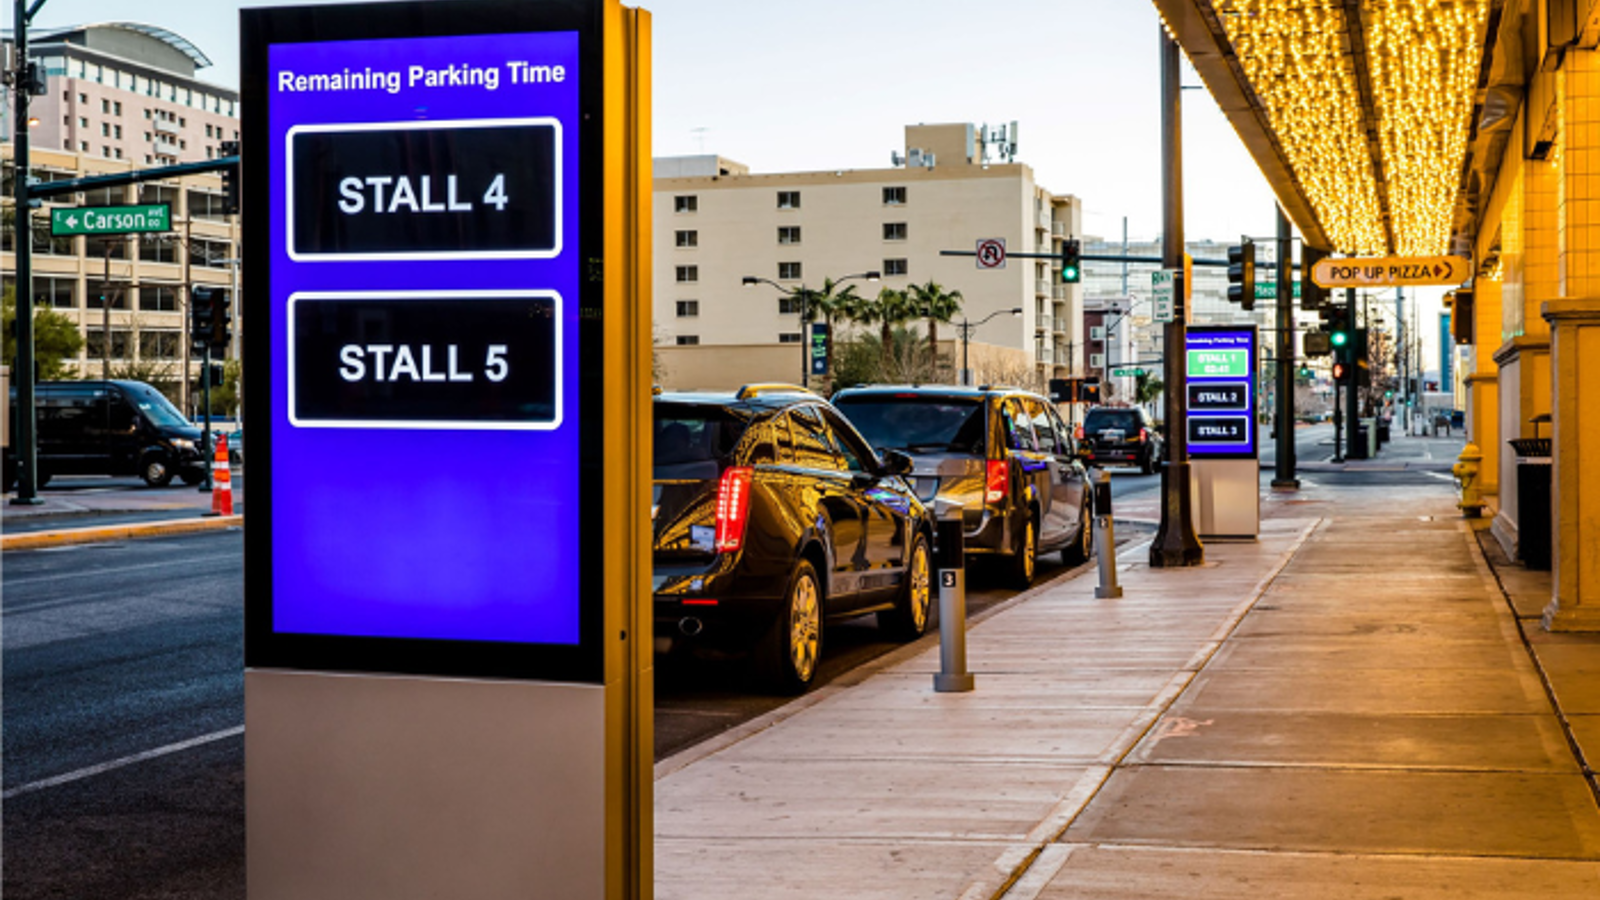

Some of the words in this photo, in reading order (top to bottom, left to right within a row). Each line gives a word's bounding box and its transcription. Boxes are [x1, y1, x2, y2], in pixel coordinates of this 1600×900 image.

[278, 67, 401, 94] Remaining
[408, 63, 499, 90] Parking
[507, 60, 566, 84] Time
[338, 174, 472, 214] STALL
[483, 174, 509, 211] 4
[83, 210, 145, 230] Carson
[1331, 266, 1360, 279] POP
[1365, 266, 1384, 279] UP
[1389, 264, 1431, 279] PIZZA
[339, 343, 473, 382] STALL
[485, 343, 509, 382] 5
[1198, 353, 1229, 363] STALL
[1231, 353, 1236, 363] 1
[1198, 391, 1228, 403] STALL
[1231, 391, 1238, 403] 2
[1198, 426, 1228, 436] STALL
[1231, 426, 1238, 436] 3
[944, 573, 954, 586] 3
